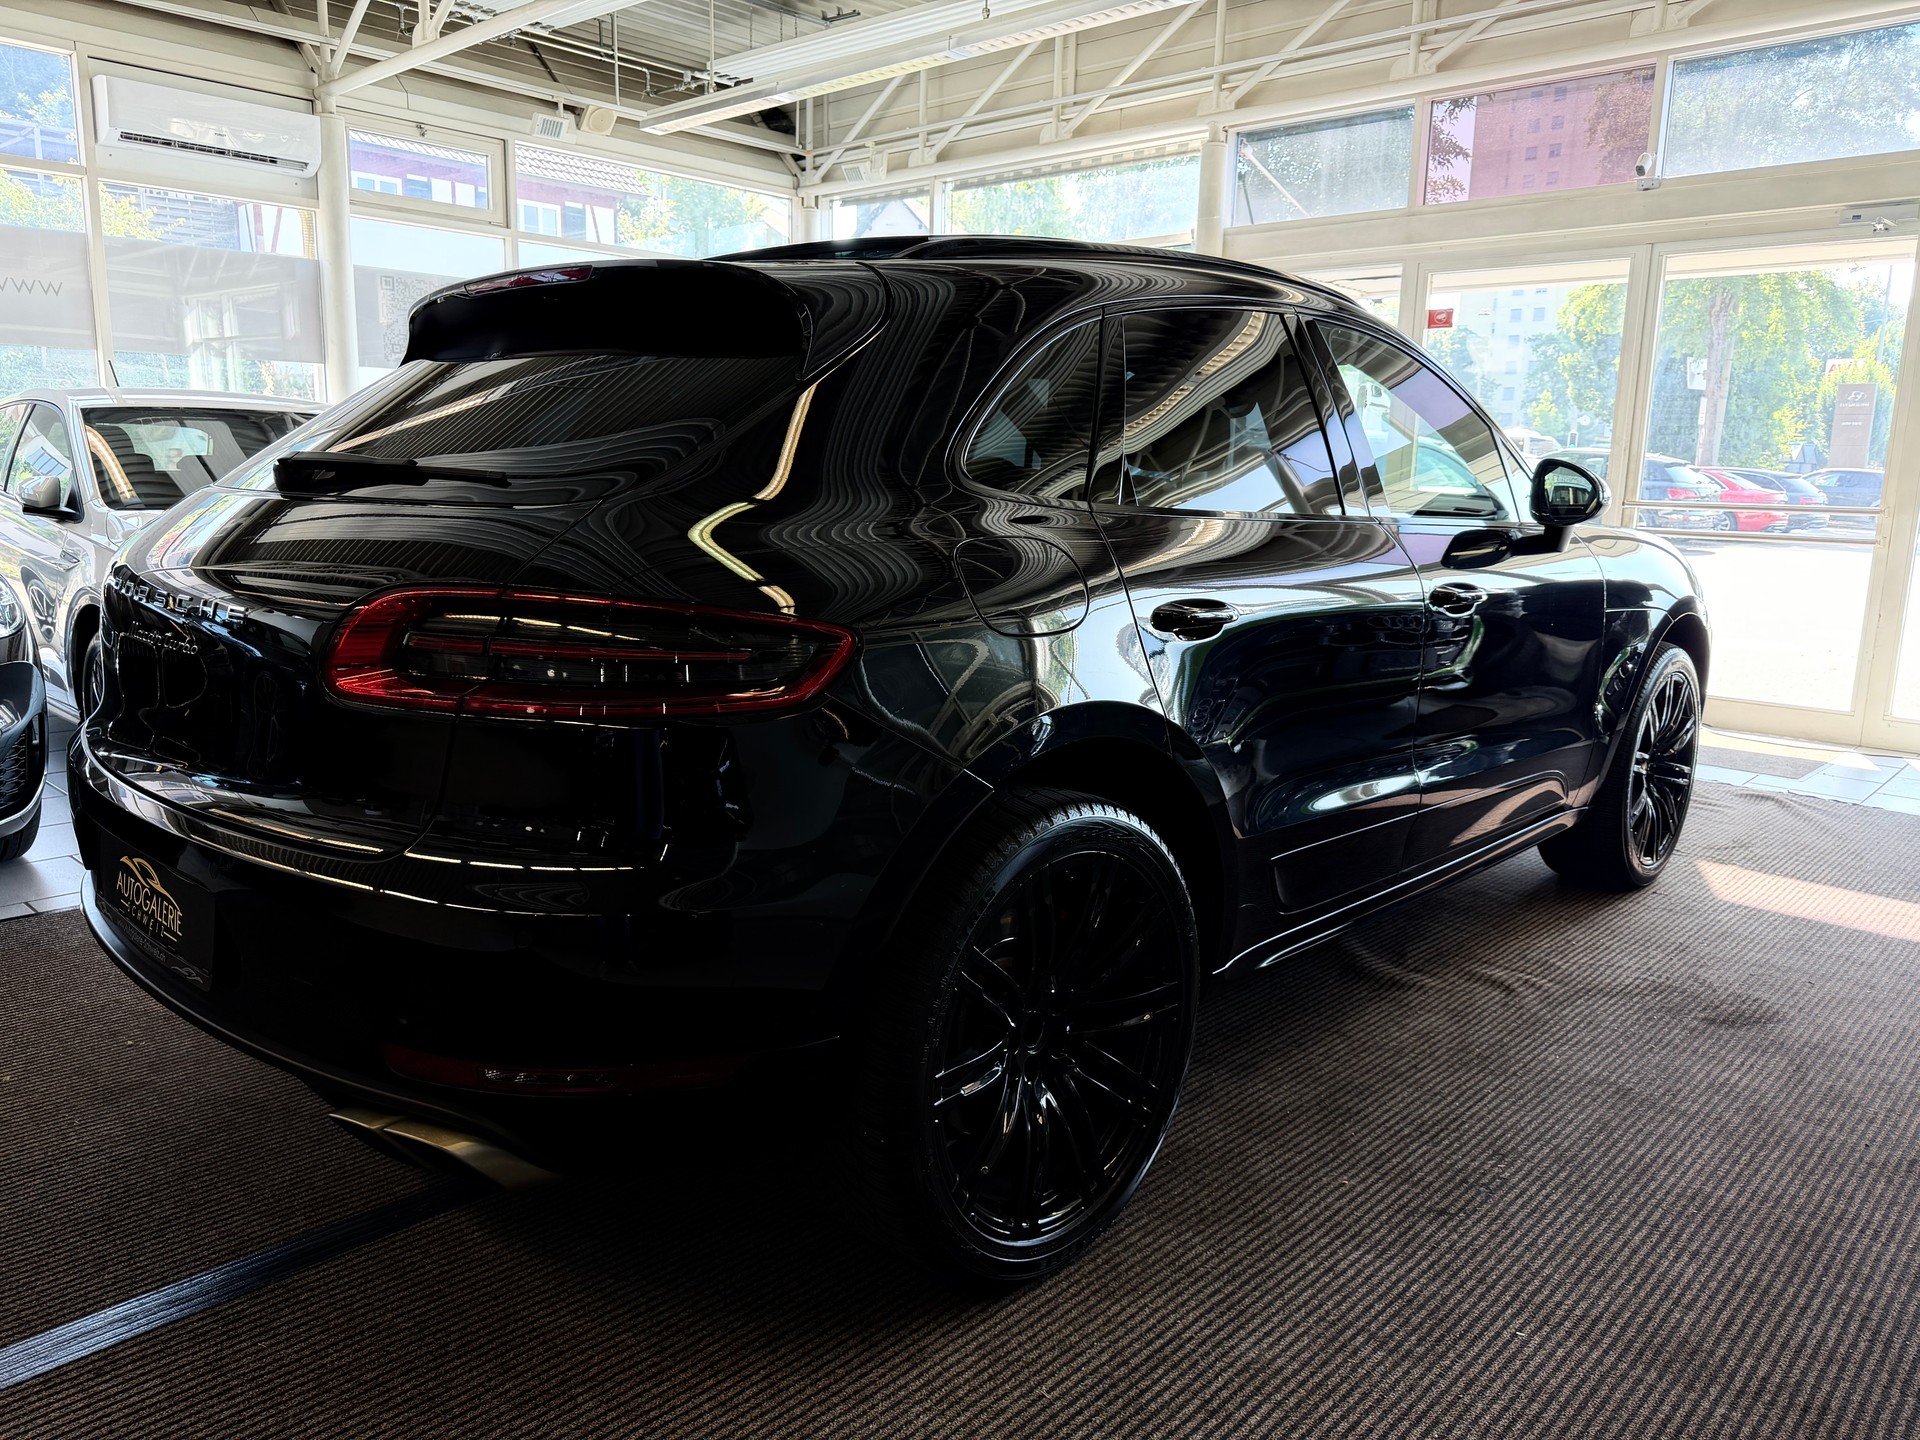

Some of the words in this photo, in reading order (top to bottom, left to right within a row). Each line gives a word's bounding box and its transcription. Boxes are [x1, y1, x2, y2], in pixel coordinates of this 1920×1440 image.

[113, 578, 250, 624] PORSCHE
[116, 870, 183, 937] AUTOGALERIE
[127, 901, 166, 938] SCHWEIZ
